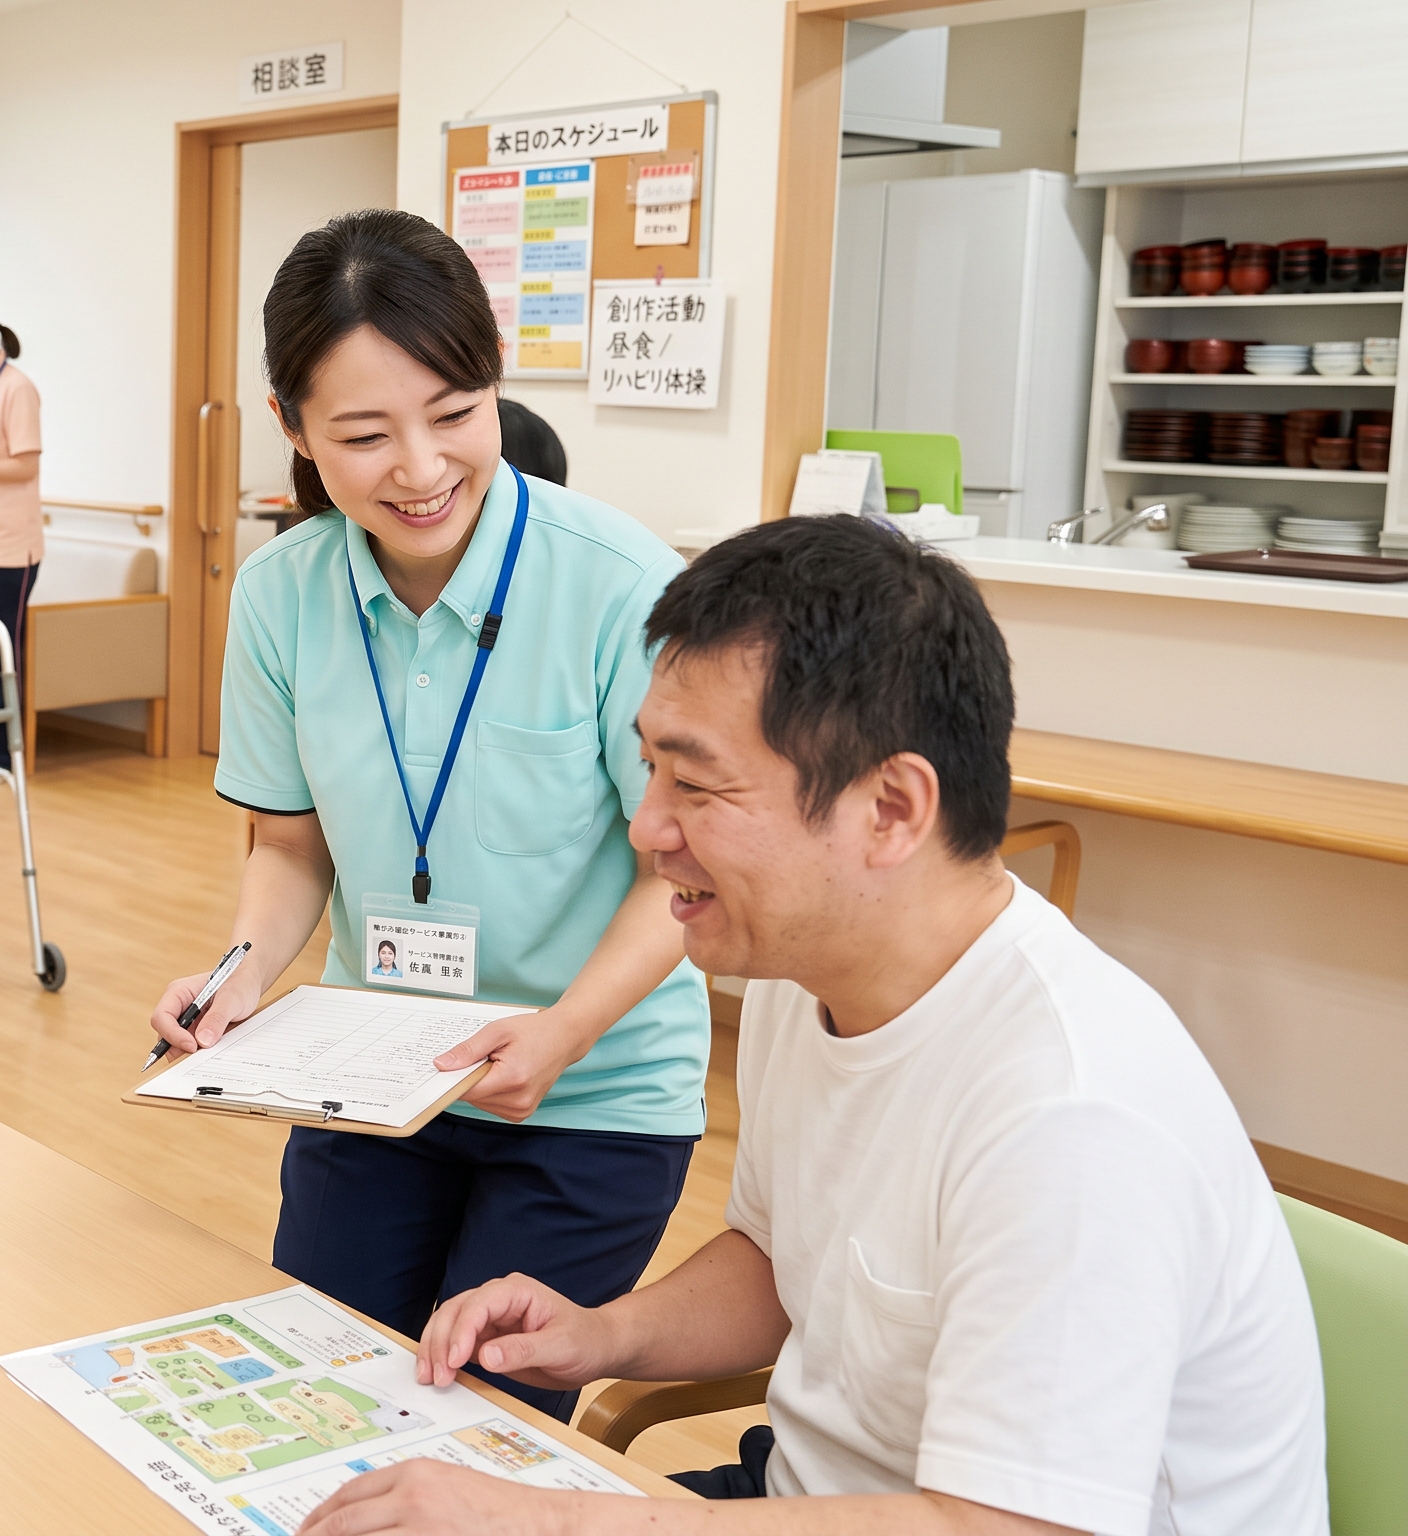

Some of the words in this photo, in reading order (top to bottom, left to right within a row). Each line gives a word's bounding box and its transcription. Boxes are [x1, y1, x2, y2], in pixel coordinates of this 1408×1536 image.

[252, 53, 326, 94] 相談室
[495, 117, 658, 155] 本日のスケジュール
[607, 294, 705, 323] 創作活動
[604, 368, 706, 395] リハビリ体操
